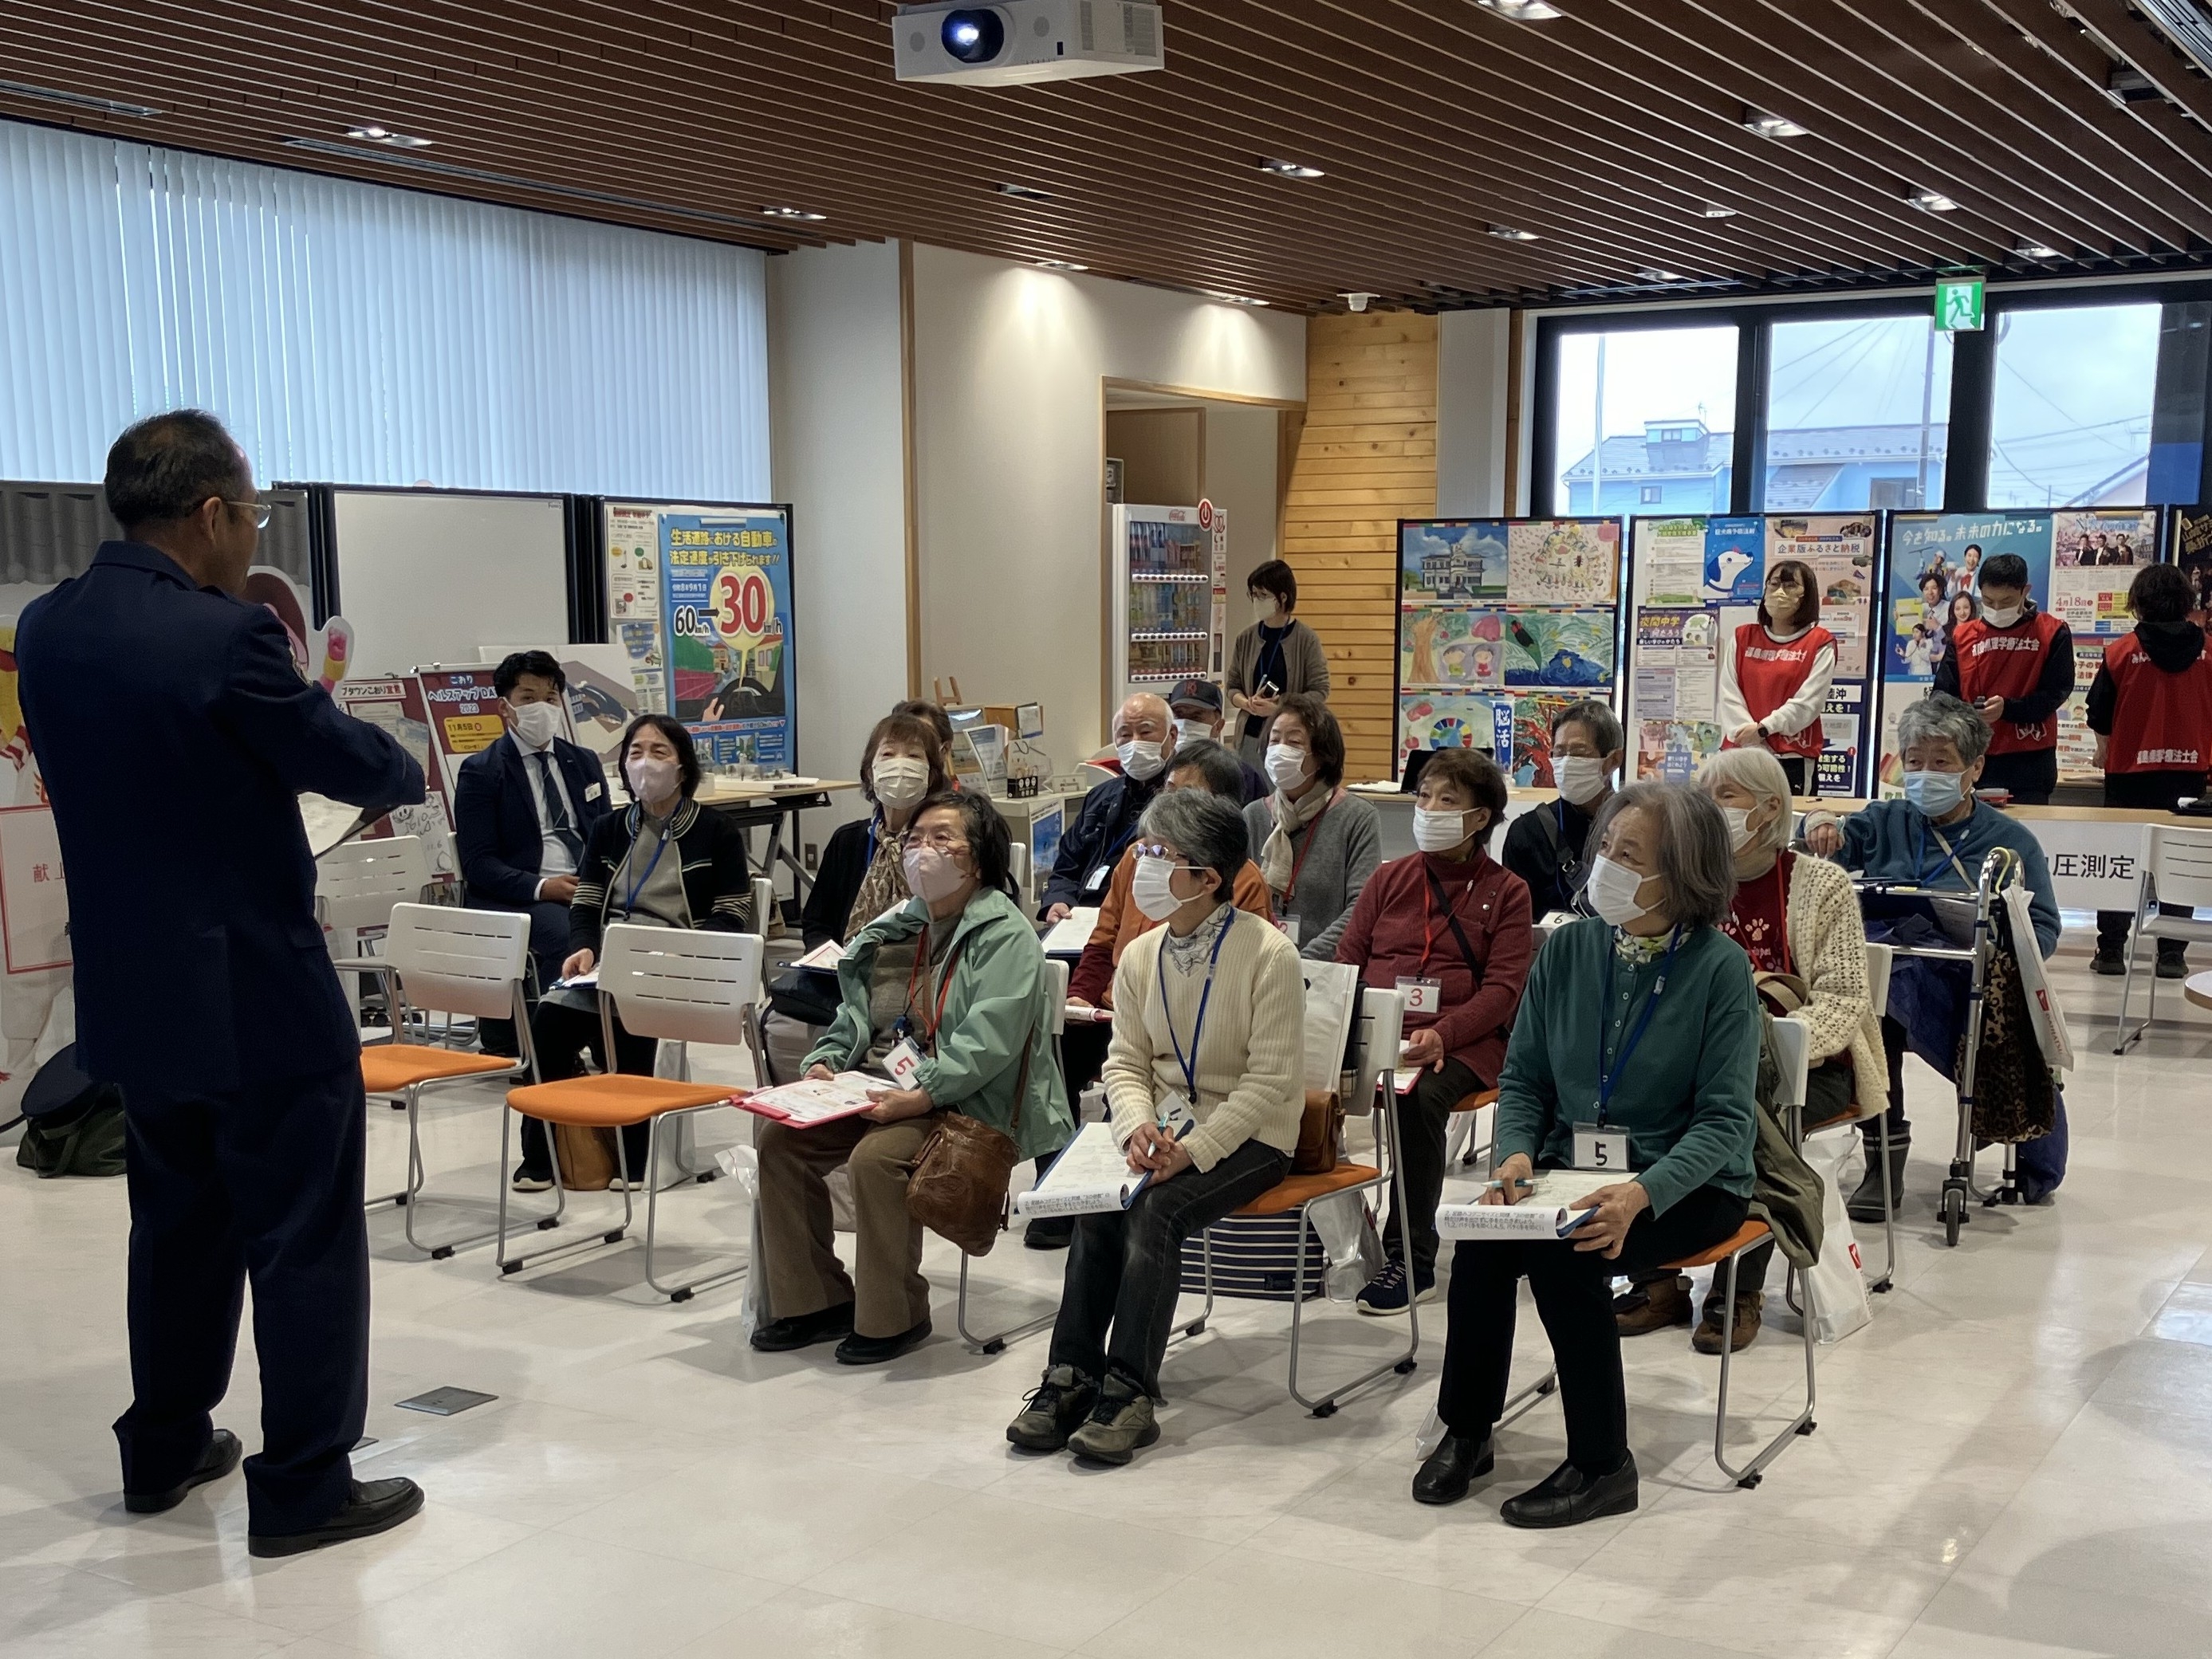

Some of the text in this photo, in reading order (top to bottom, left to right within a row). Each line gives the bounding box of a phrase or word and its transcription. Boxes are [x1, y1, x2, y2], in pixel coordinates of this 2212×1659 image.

[1903, 520, 2042, 546] 今を知る。未来の力になる。
[1777, 543, 1860, 554] 企業版ふるさと納税
[720, 574, 767, 635] 30
[675, 606, 696, 635] 60
[1639, 615, 1681, 627] 夜間中学
[427, 686, 498, 702] ヘルスアップ DA
[1495, 708, 1510, 748] 脳活
[2045, 853, 2135, 879] 圧測定
[1409, 988, 1423, 1007] 3
[894, 1056, 915, 1075] 5
[1595, 1141, 1608, 1167] 5
